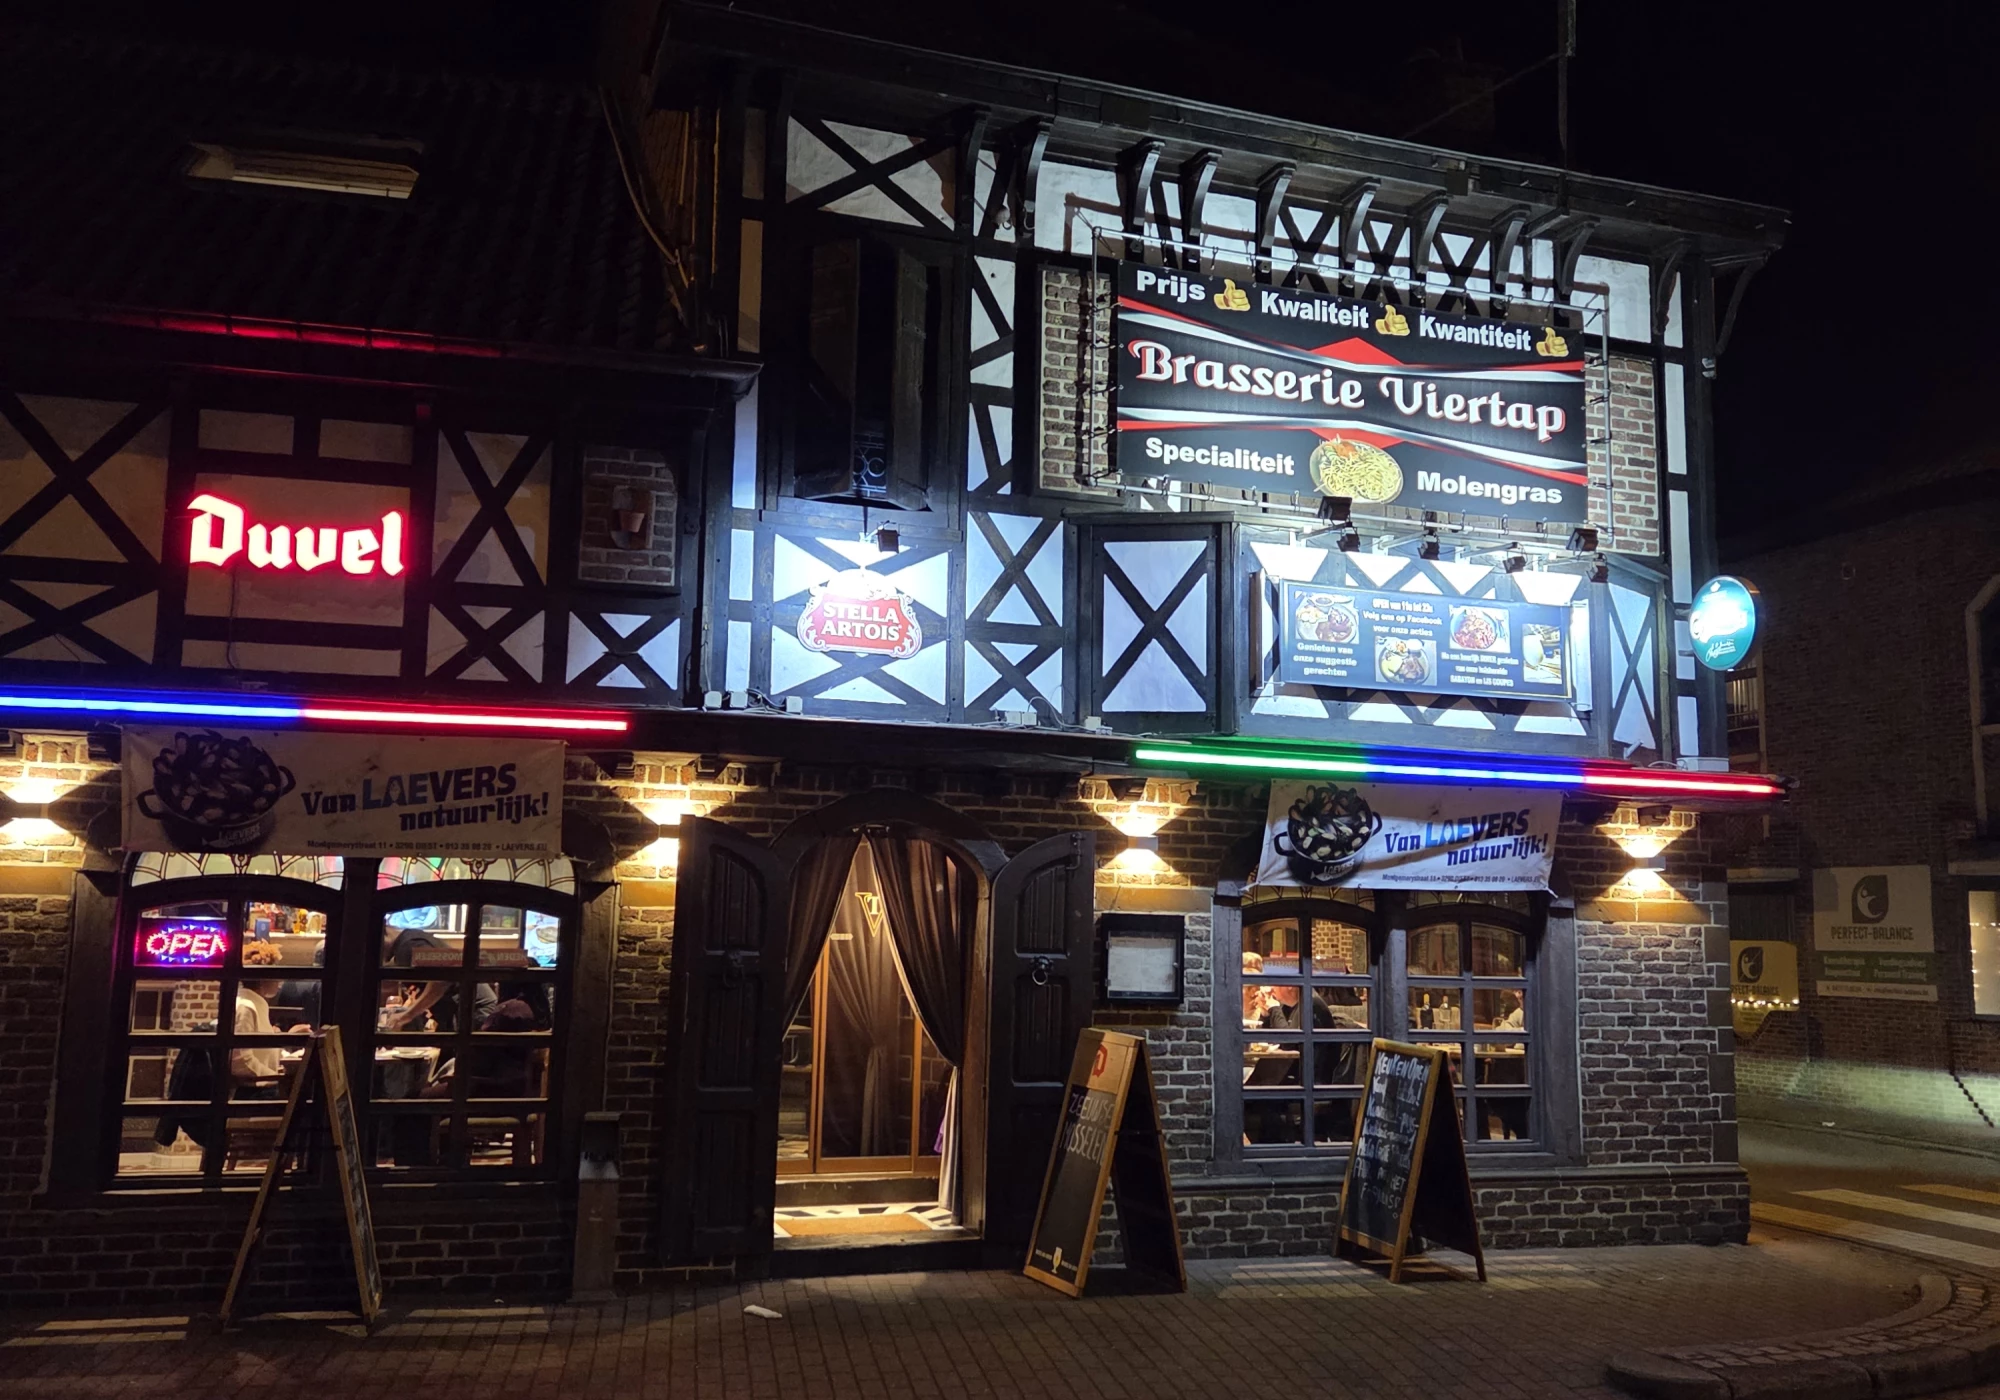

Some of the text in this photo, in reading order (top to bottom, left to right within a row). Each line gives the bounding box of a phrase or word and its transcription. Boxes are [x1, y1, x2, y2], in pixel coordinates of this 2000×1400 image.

[1136, 270, 1206, 301] Prijs
[1261, 290, 1369, 330] Kwaliteit
[1419, 314, 1532, 352] Kwantiteit
[1128, 338, 1566, 442] Brasserie Viertap
[1145, 437, 1295, 476] Specialiteit
[1417, 470, 1563, 505] Molengras
[187, 494, 404, 576] Duvel
[823, 601, 899, 623] STELLA
[1363, 611, 1379, 621] Volg
[1396, 615, 1405, 623] op
[1407, 615, 1442, 625] Facebook
[821, 620, 901, 641] ARTOIS
[1391, 627, 1408, 635] onze
[1410, 628, 1433, 636] acties
[1293, 656, 1357, 668] onze suggestie
[1297, 642, 1353, 655] Genieten van
[1304, 667, 1347, 677] gerechten
[301, 764, 517, 816] Van LAEVERS
[400, 792, 549, 832] natuurlijk!
[1385, 809, 1530, 853] Van LAEVERS
[1446, 834, 1547, 866] natuurlijk!
[146, 933, 226, 958] OPEN
[1831, 927, 1914, 940] PERFECT-BALANCE
[1375, 1052, 1430, 1084] KEUKEN OPEN
